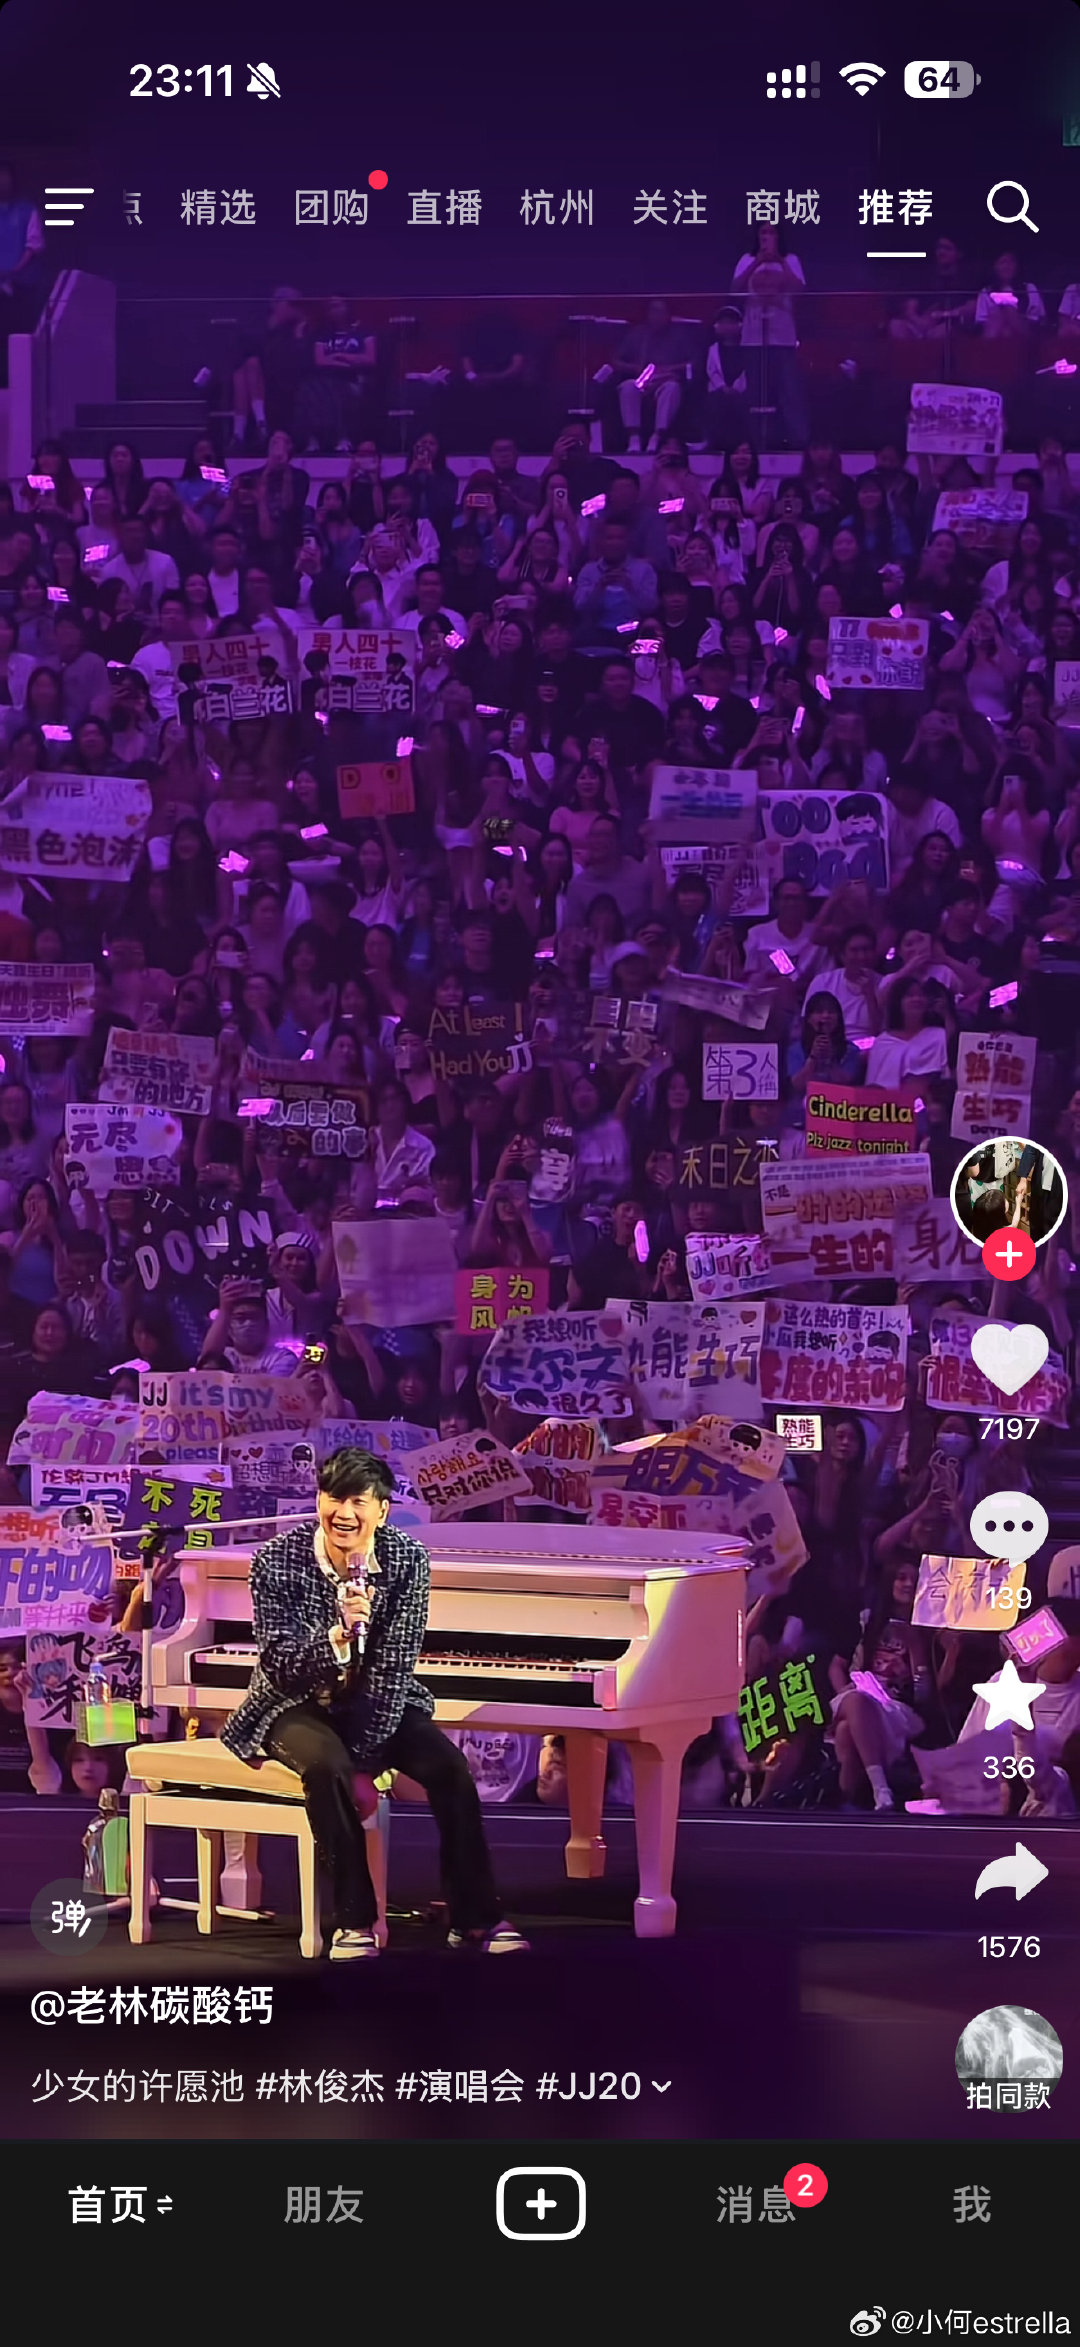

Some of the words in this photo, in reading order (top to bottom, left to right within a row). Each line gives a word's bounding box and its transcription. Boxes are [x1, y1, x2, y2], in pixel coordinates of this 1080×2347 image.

[429, 1007, 459, 1038] At
[464, 1005, 505, 1036] Least
[429, 1050, 472, 1081] Had
[809, 1094, 912, 1123] Cinderella
[807, 1131, 824, 1148] Plz
[826, 1133, 853, 1151] jazz
[857, 1138, 911, 1155] tonight
[135, 1209, 273, 1290] DOWN
[471, 1274, 534, 1300] 身为
[143, 1382, 167, 1407] JJ
[228, 1386, 274, 1409] my
[142, 1411, 219, 1443] 20th
[141, 1478, 222, 1522] 不死
[738, 1655, 824, 1752] 距离
